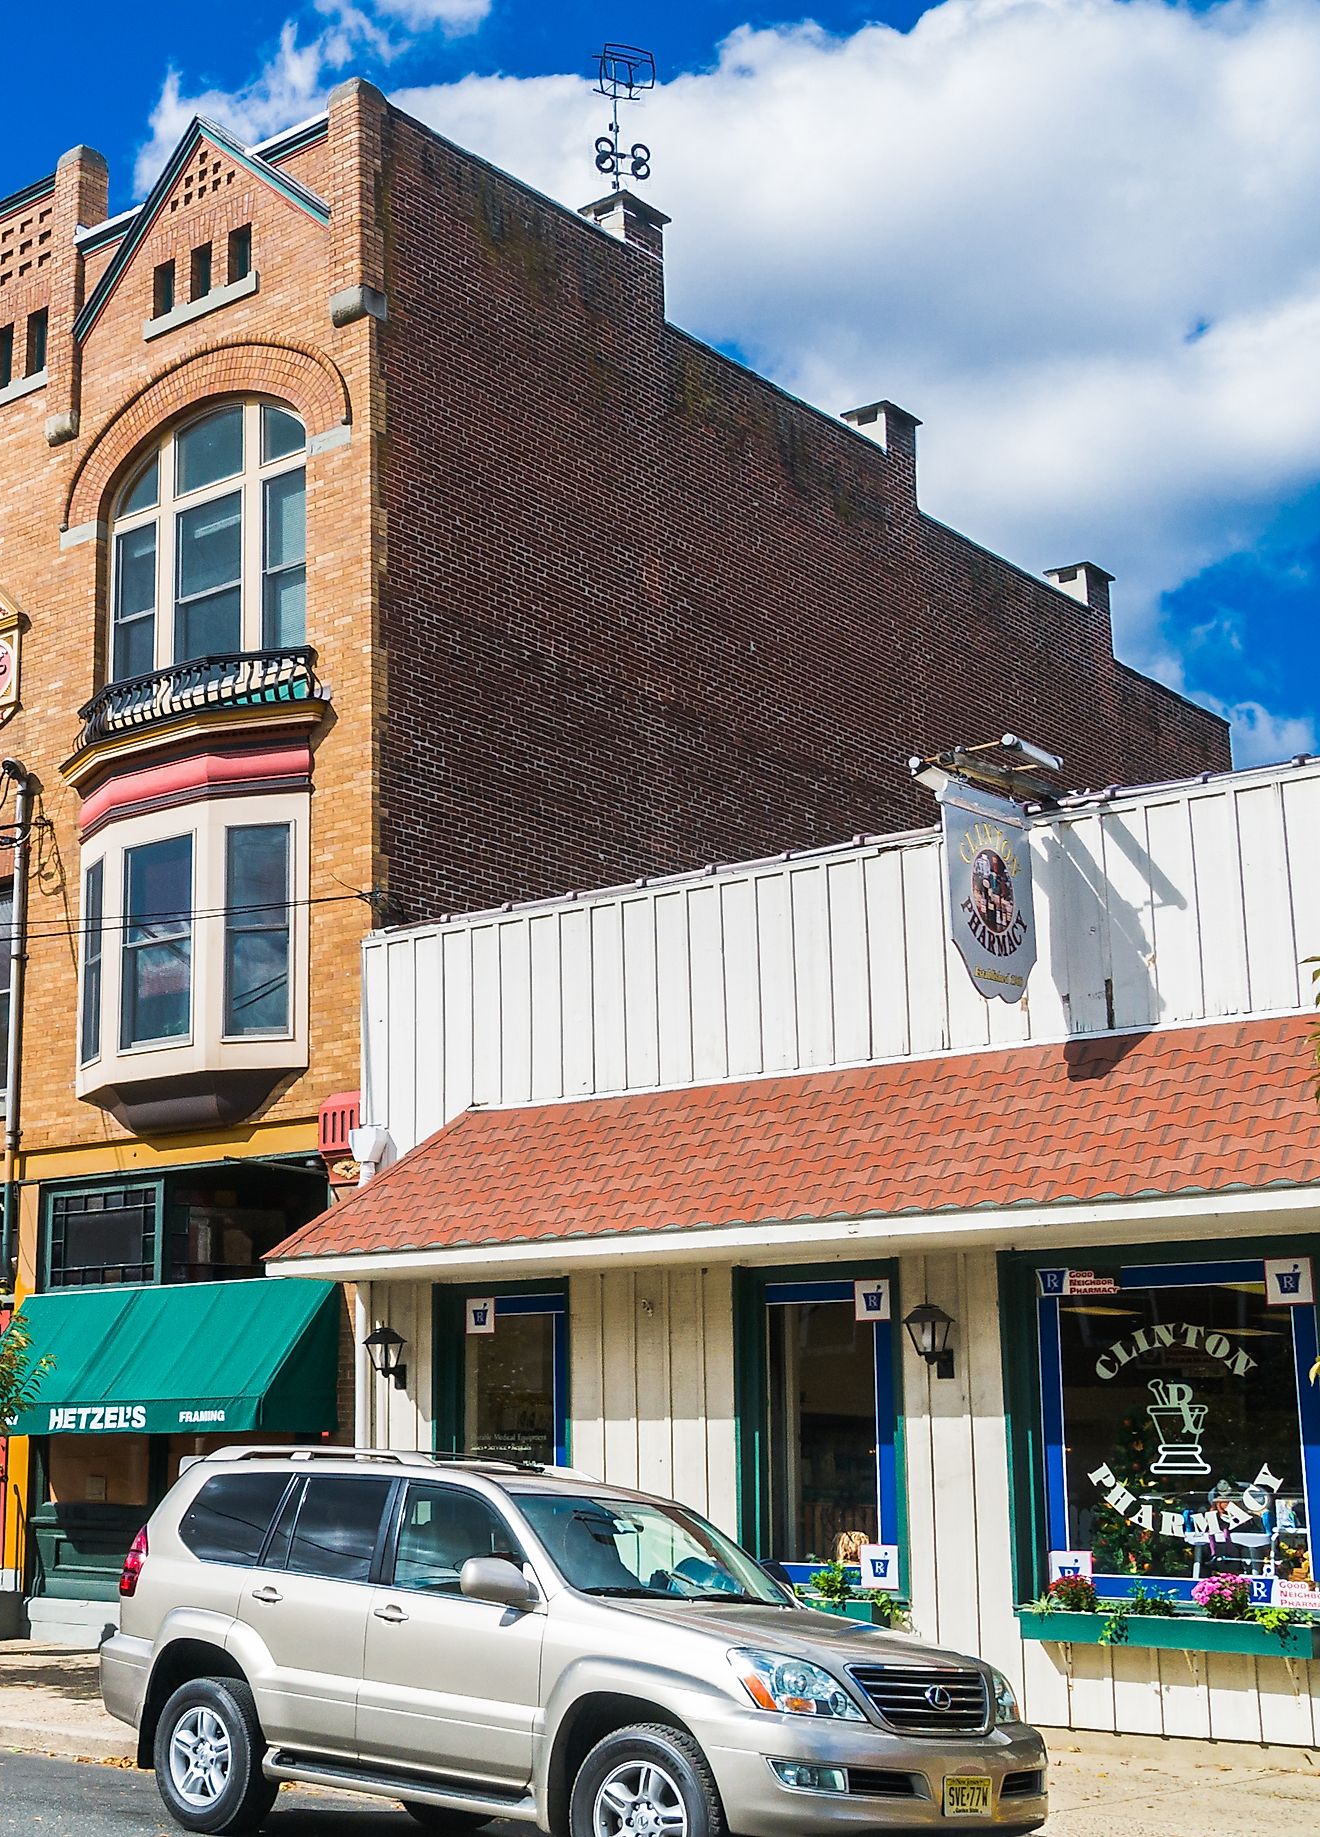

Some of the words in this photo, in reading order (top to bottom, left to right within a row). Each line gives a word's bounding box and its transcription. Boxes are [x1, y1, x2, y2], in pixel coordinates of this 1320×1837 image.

[960, 822, 1021, 877] CLINTON
[961, 896, 1027, 956] PHARMACY
[1095, 1322, 1258, 1380] CLINTON
[48, 1405, 146, 1431] HETZEL'S
[178, 1409, 225, 1424] FRAMING
[1087, 1462, 1284, 1537] PHARMACY
[1279, 1581, 1307, 1589] GOOD
